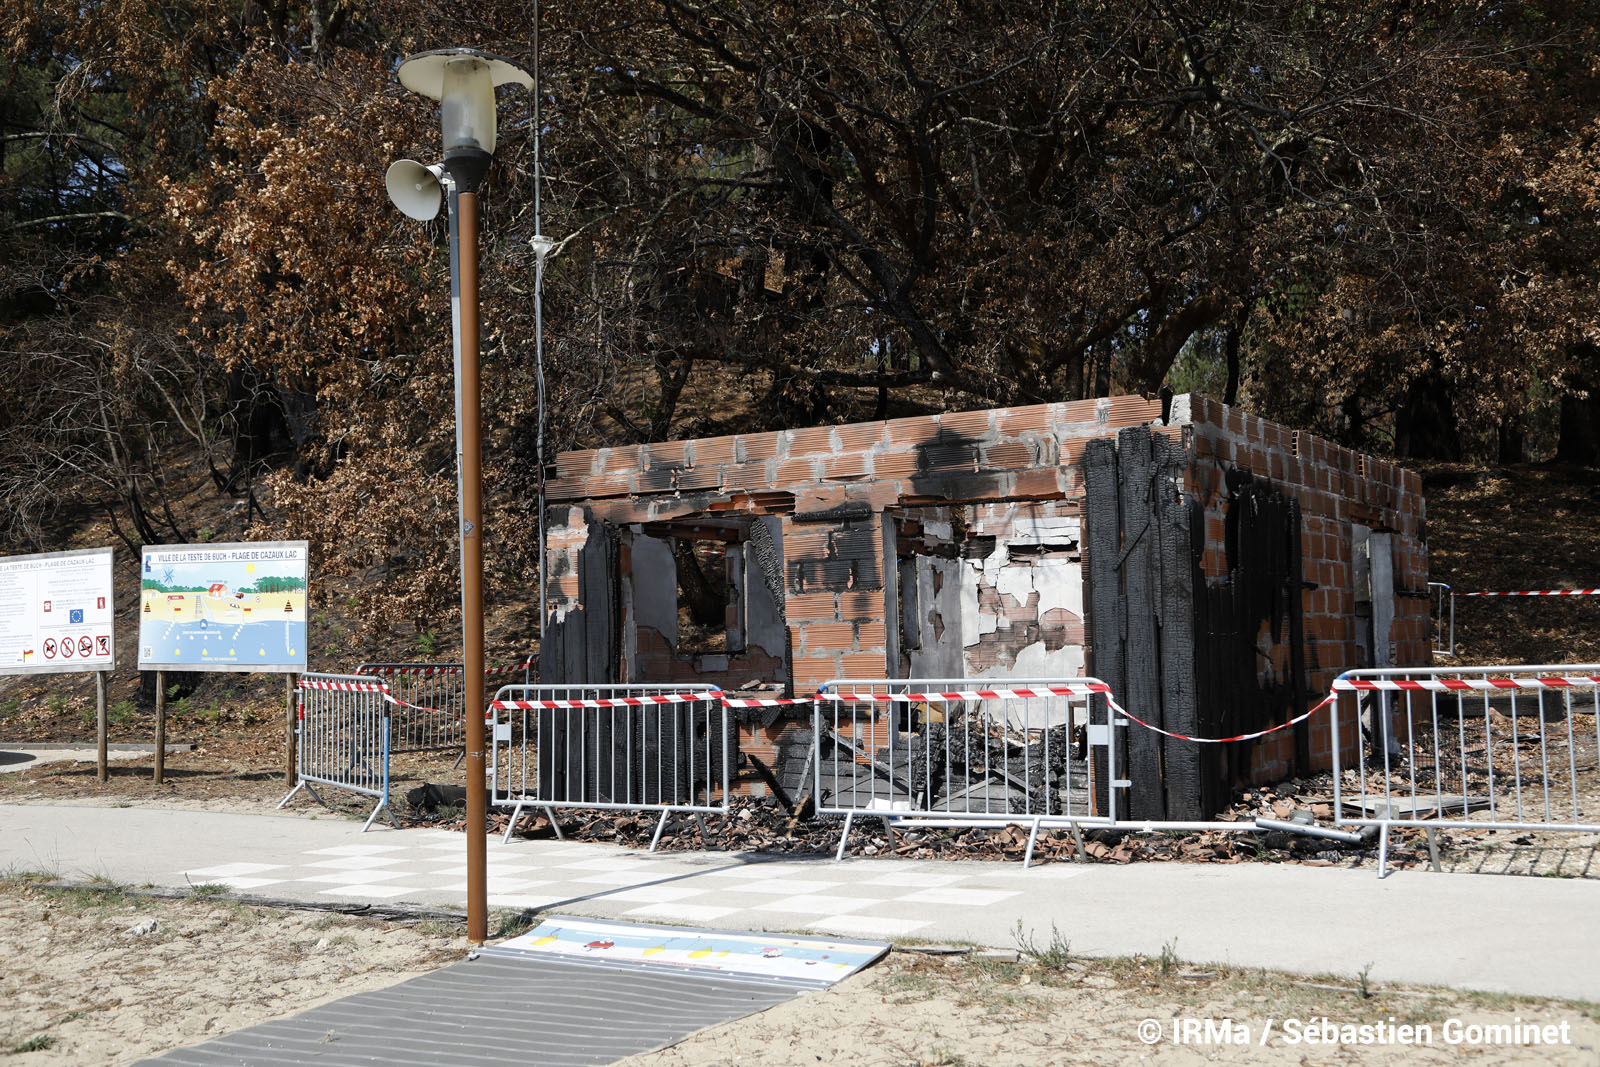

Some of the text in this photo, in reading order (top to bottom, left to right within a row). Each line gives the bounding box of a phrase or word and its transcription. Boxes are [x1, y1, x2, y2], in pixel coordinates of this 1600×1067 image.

[158, 554, 171, 562] VILLE
[172, 554, 179, 562] DE
[180, 553, 187, 561] LA
[187, 553, 203, 561] TESTE
[212, 552, 227, 560] BUCH
[232, 551, 250, 559] PLAGE
[251, 551, 259, 559] DE
[260, 551, 284, 559] CAZAUX
[285, 550, 297, 558] LAC
